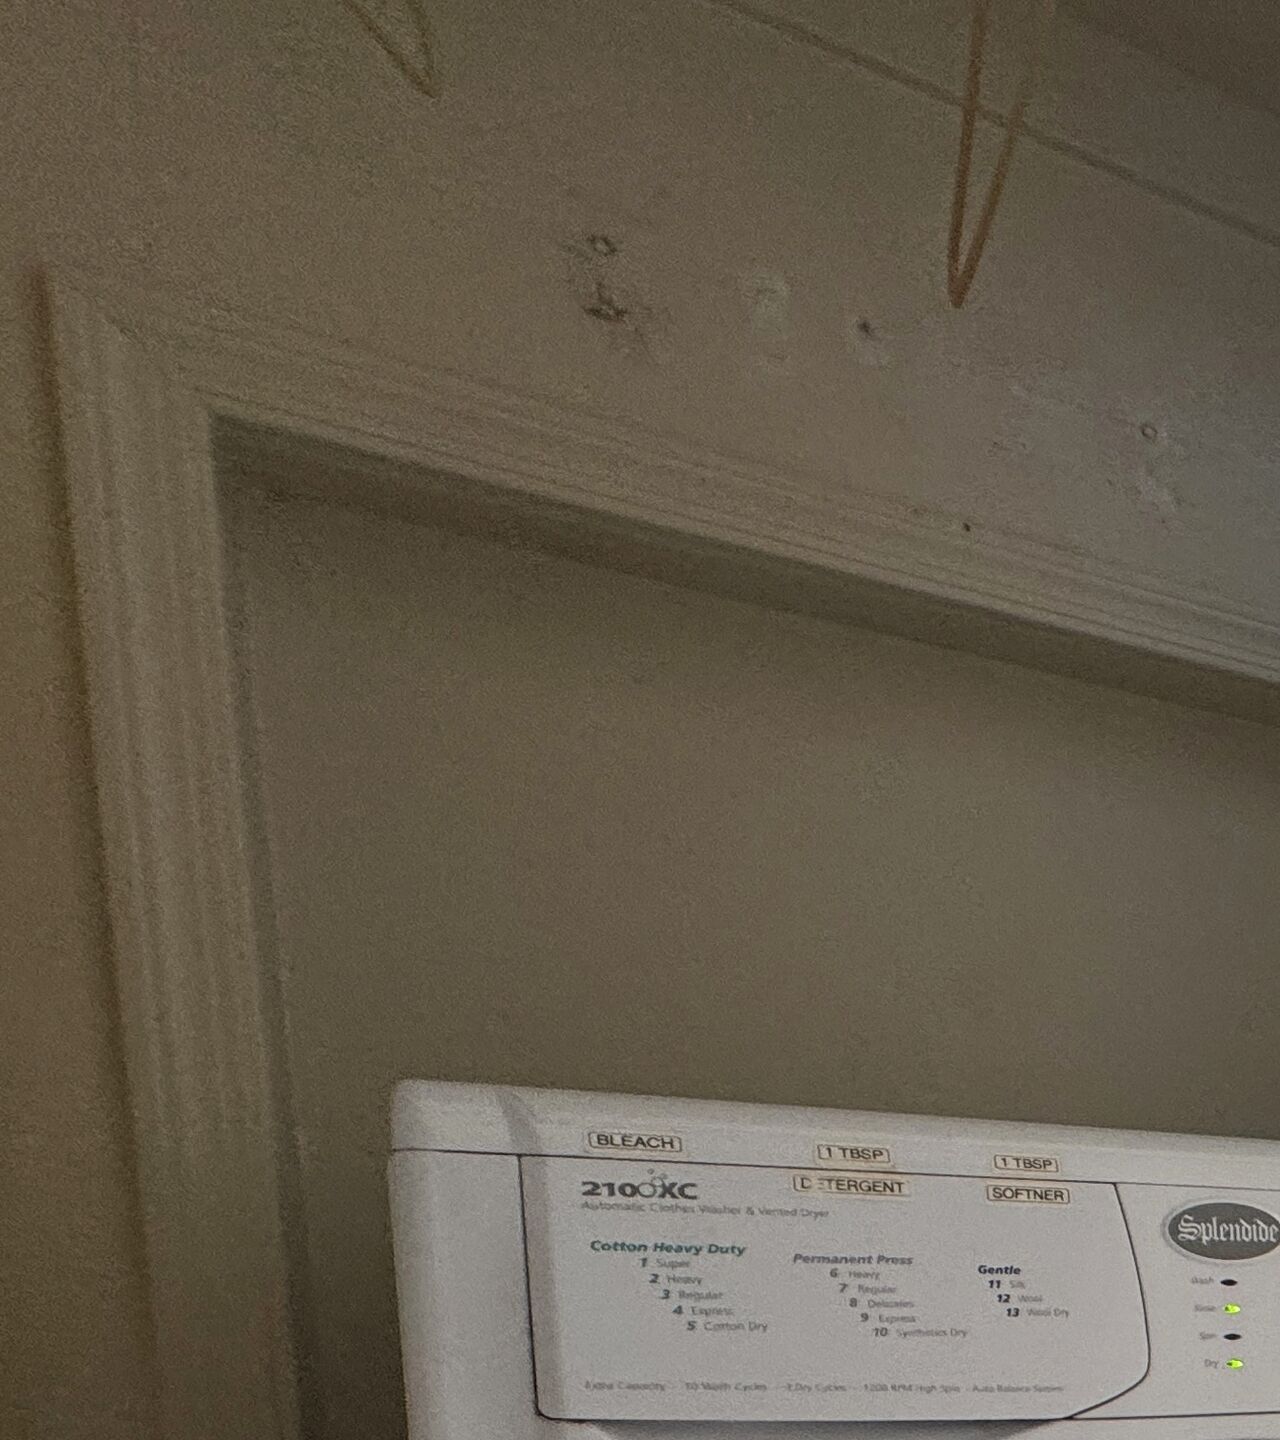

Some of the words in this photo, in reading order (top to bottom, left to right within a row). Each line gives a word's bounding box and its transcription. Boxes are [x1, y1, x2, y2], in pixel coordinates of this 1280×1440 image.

[596, 1134, 675, 1149] BLEACH
[826, 1147, 833, 1158] 1
[841, 1149, 884, 1160] TBSP
[1001, 1157, 1008, 1168] 1
[1013, 1158, 1053, 1169] TBSP
[580, 1180, 698, 1201] 2100XC
[991, 1187, 1065, 1201] SOFTNER
[1177, 1214, 1280, 1246] Splendide
[590, 1240, 648, 1253] Cotton
[653, 1242, 703, 1256] Heavy
[707, 1243, 748, 1257] Duty
[640, 1257, 648, 1268] 1
[793, 1253, 874, 1266] Permanent
[876, 1254, 914, 1266] Press
[829, 1268, 839, 1279] 6
[977, 1264, 1022, 1276] Gentle
[649, 1273, 660, 1284] 2
[988, 1279, 1002, 1289] 11
[838, 1283, 849, 1294] 7
[660, 1289, 671, 1300] 3
[996, 1293, 1011, 1304] 12
[672, 1305, 683, 1316] 4
[1006, 1307, 1020, 1318] 13
[860, 1312, 869, 1323] 9
[686, 1320, 697, 1331] 5
[873, 1327, 889, 1338] 10
